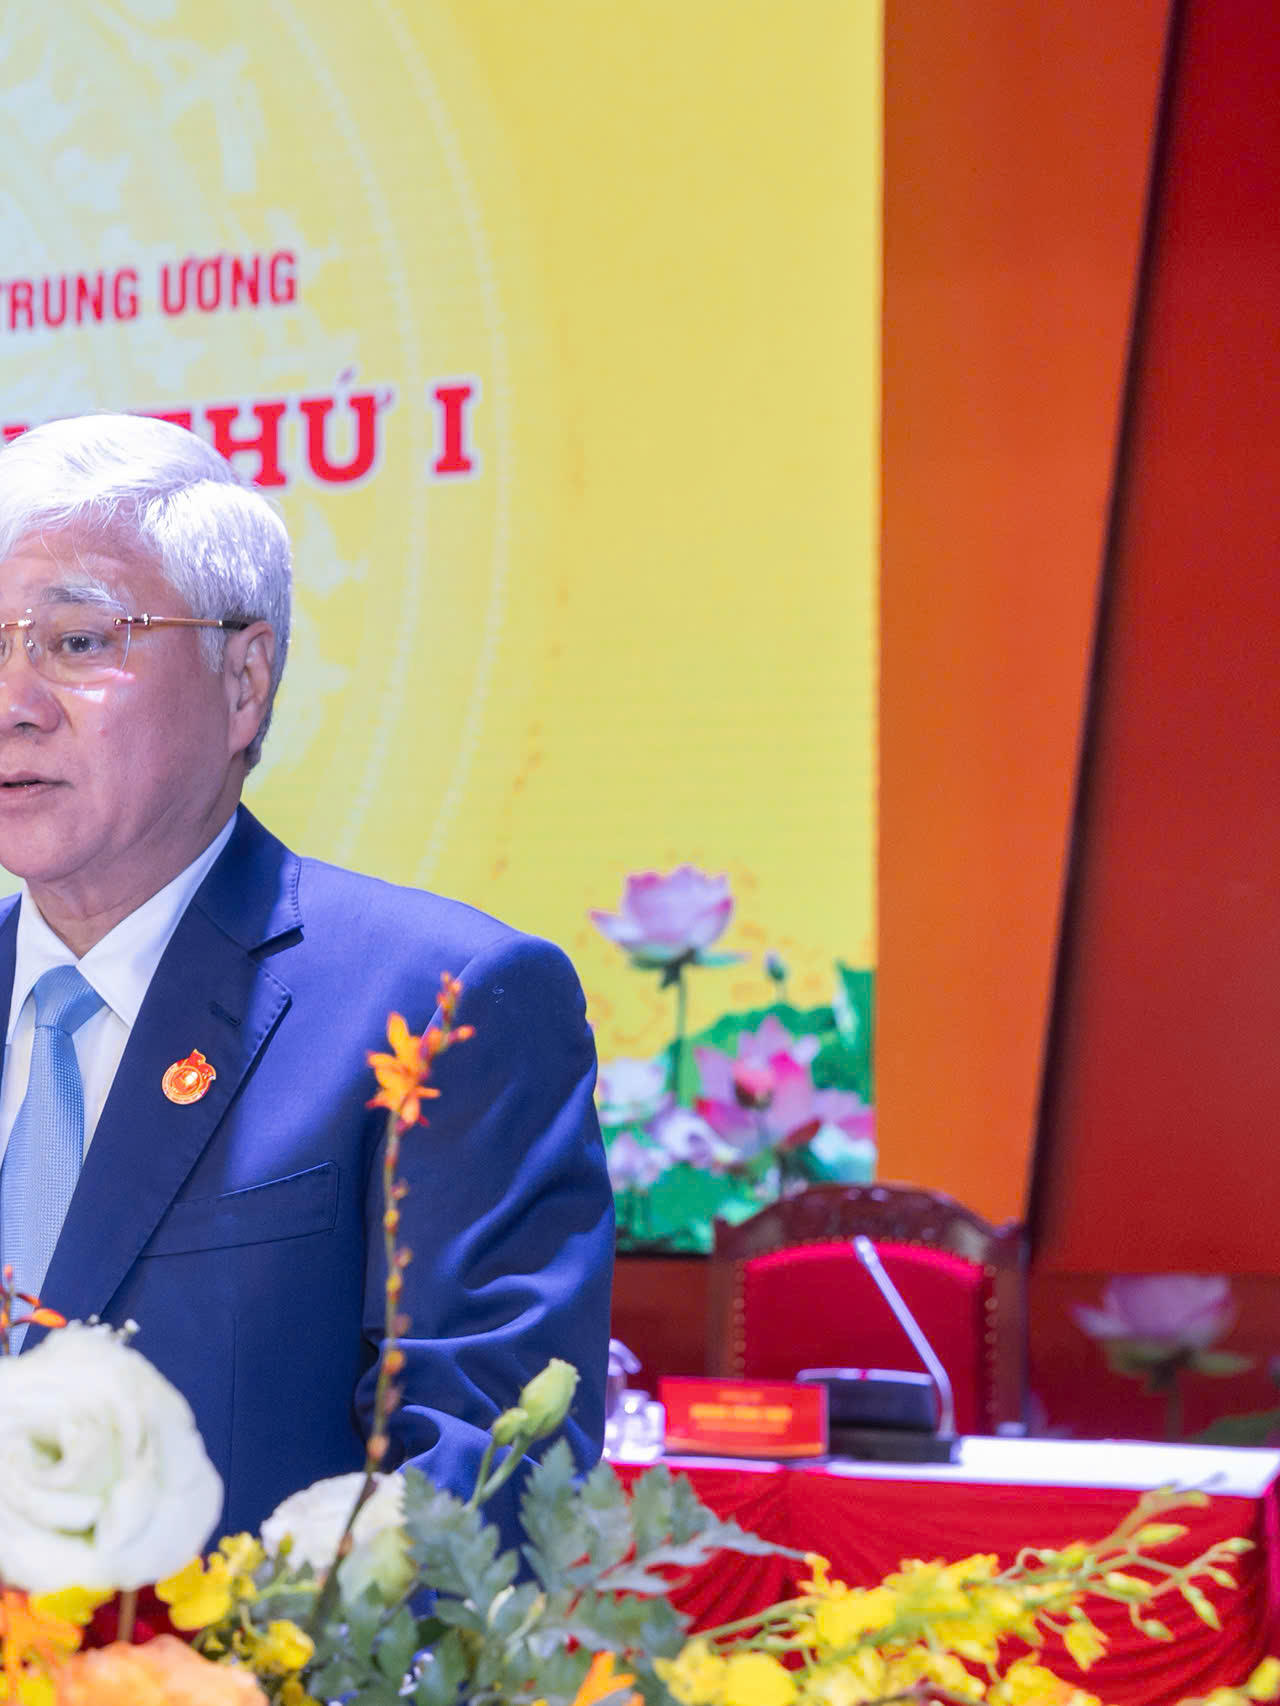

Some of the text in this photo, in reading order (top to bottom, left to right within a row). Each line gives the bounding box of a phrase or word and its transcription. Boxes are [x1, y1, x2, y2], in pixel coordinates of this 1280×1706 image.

[160, 249, 299, 317] ƯƠNG
[142, 364, 394, 489] HỨ
[434, 385, 473, 474] I
